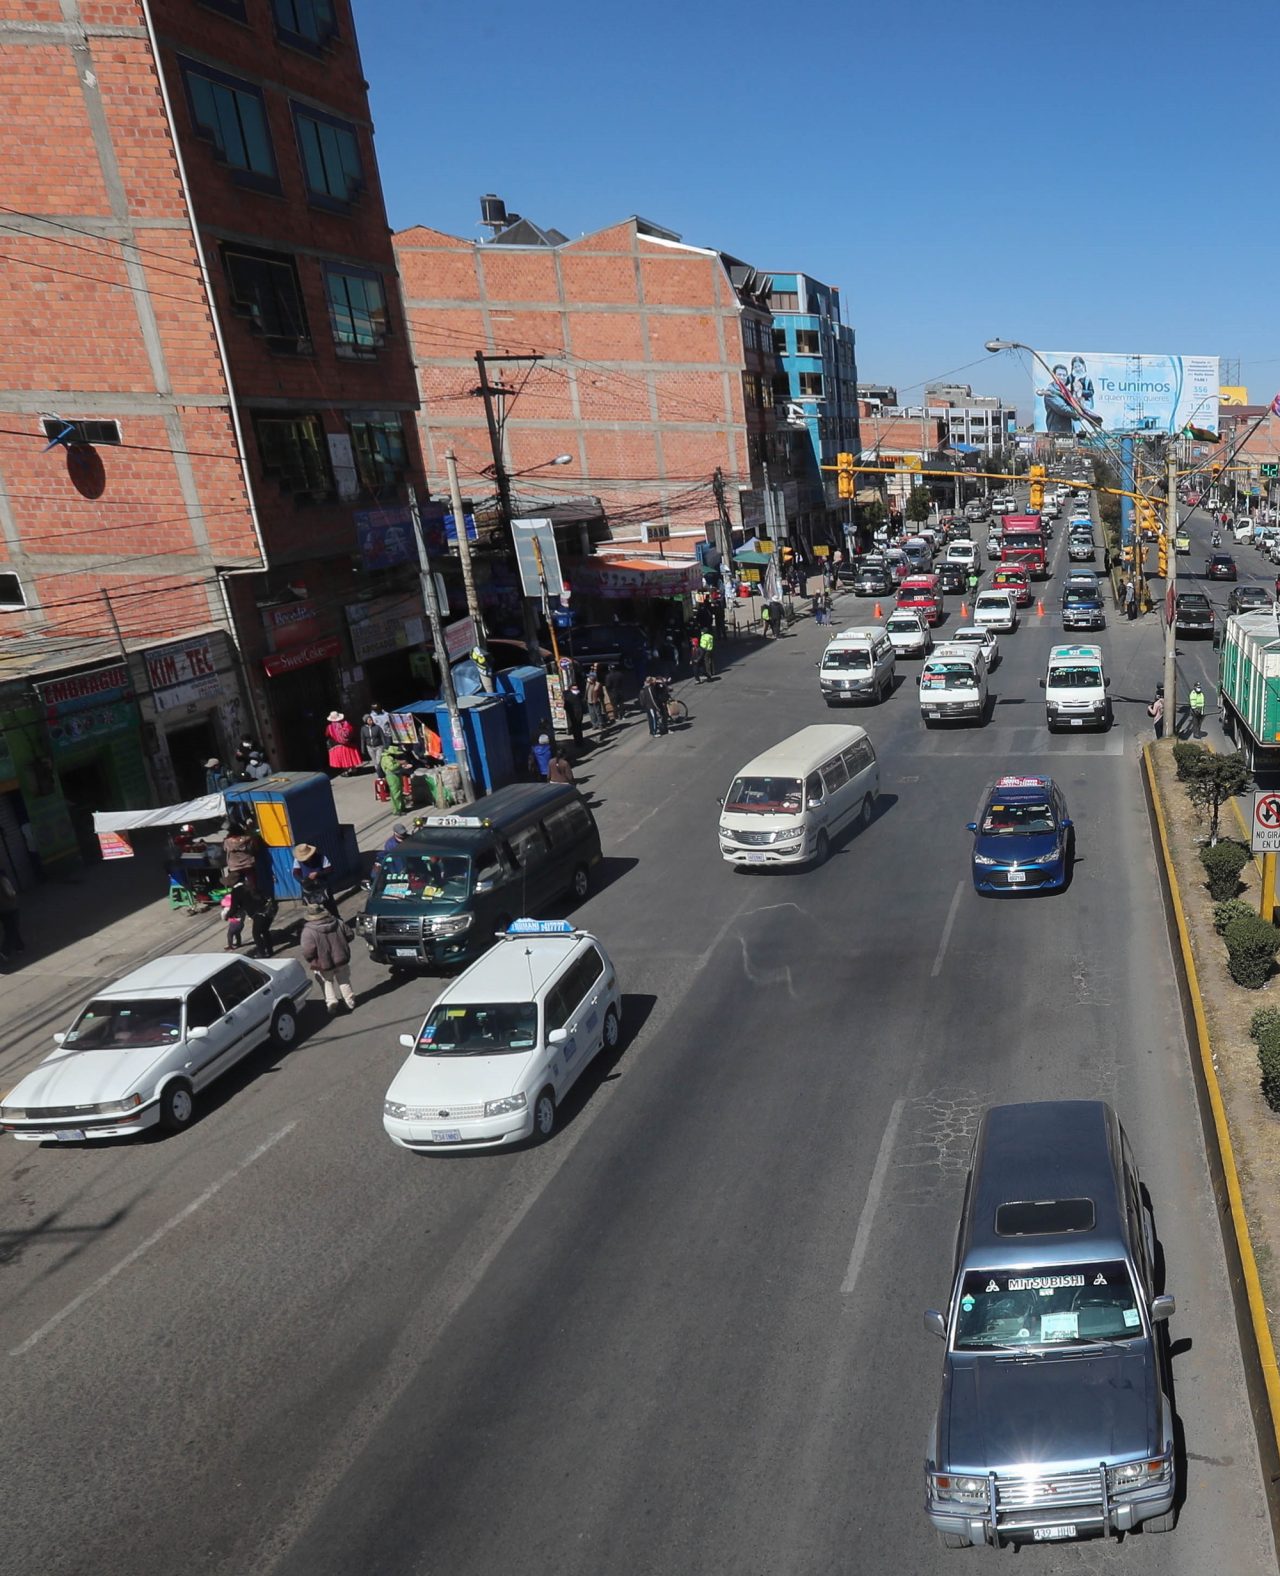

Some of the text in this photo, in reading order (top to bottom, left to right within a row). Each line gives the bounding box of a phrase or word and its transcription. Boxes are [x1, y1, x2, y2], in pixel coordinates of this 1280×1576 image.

[1099, 377, 1170, 393] Te unimos
[1262, 464, 1279, 477] 42
[149, 655, 178, 689] KIM
[185, 646, 214, 678] TEC
[44, 667, 129, 706] EMBRAGUE
[1256, 831, 1265, 839] NO
[1262, 840, 1280, 849] EN U
[1007, 1275, 1085, 1291] MITSUBISHI
[1034, 1528, 1052, 1538] 439
